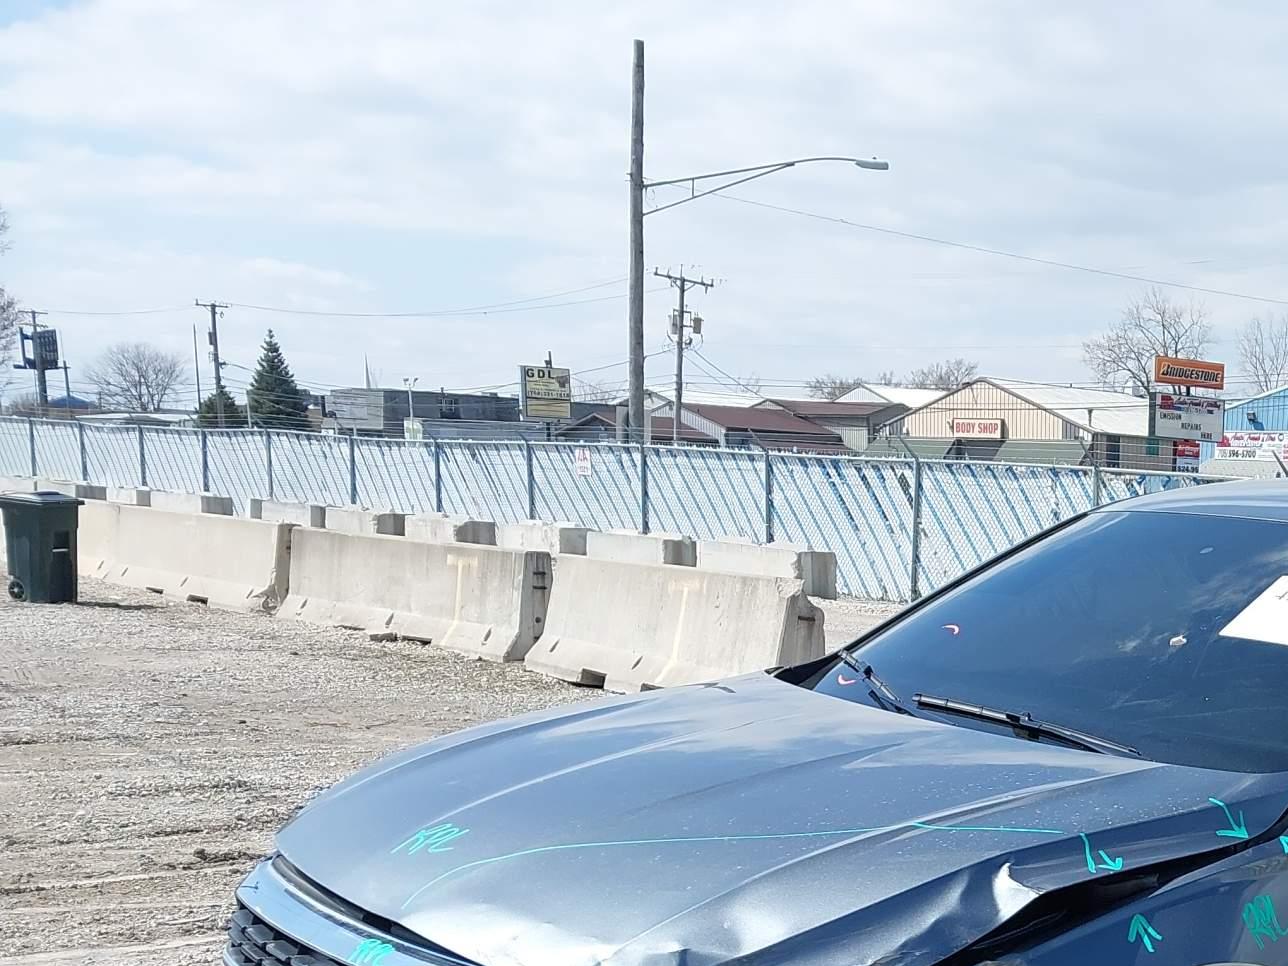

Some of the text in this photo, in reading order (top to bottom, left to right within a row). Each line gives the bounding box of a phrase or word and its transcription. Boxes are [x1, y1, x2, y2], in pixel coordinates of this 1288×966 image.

[526, 368, 555, 379] GDL
[1161, 362, 1222, 383] BRIDGESTONE
[955, 422, 998, 434] BODY SHOP
[1181, 422, 1202, 431] REPAIRS
